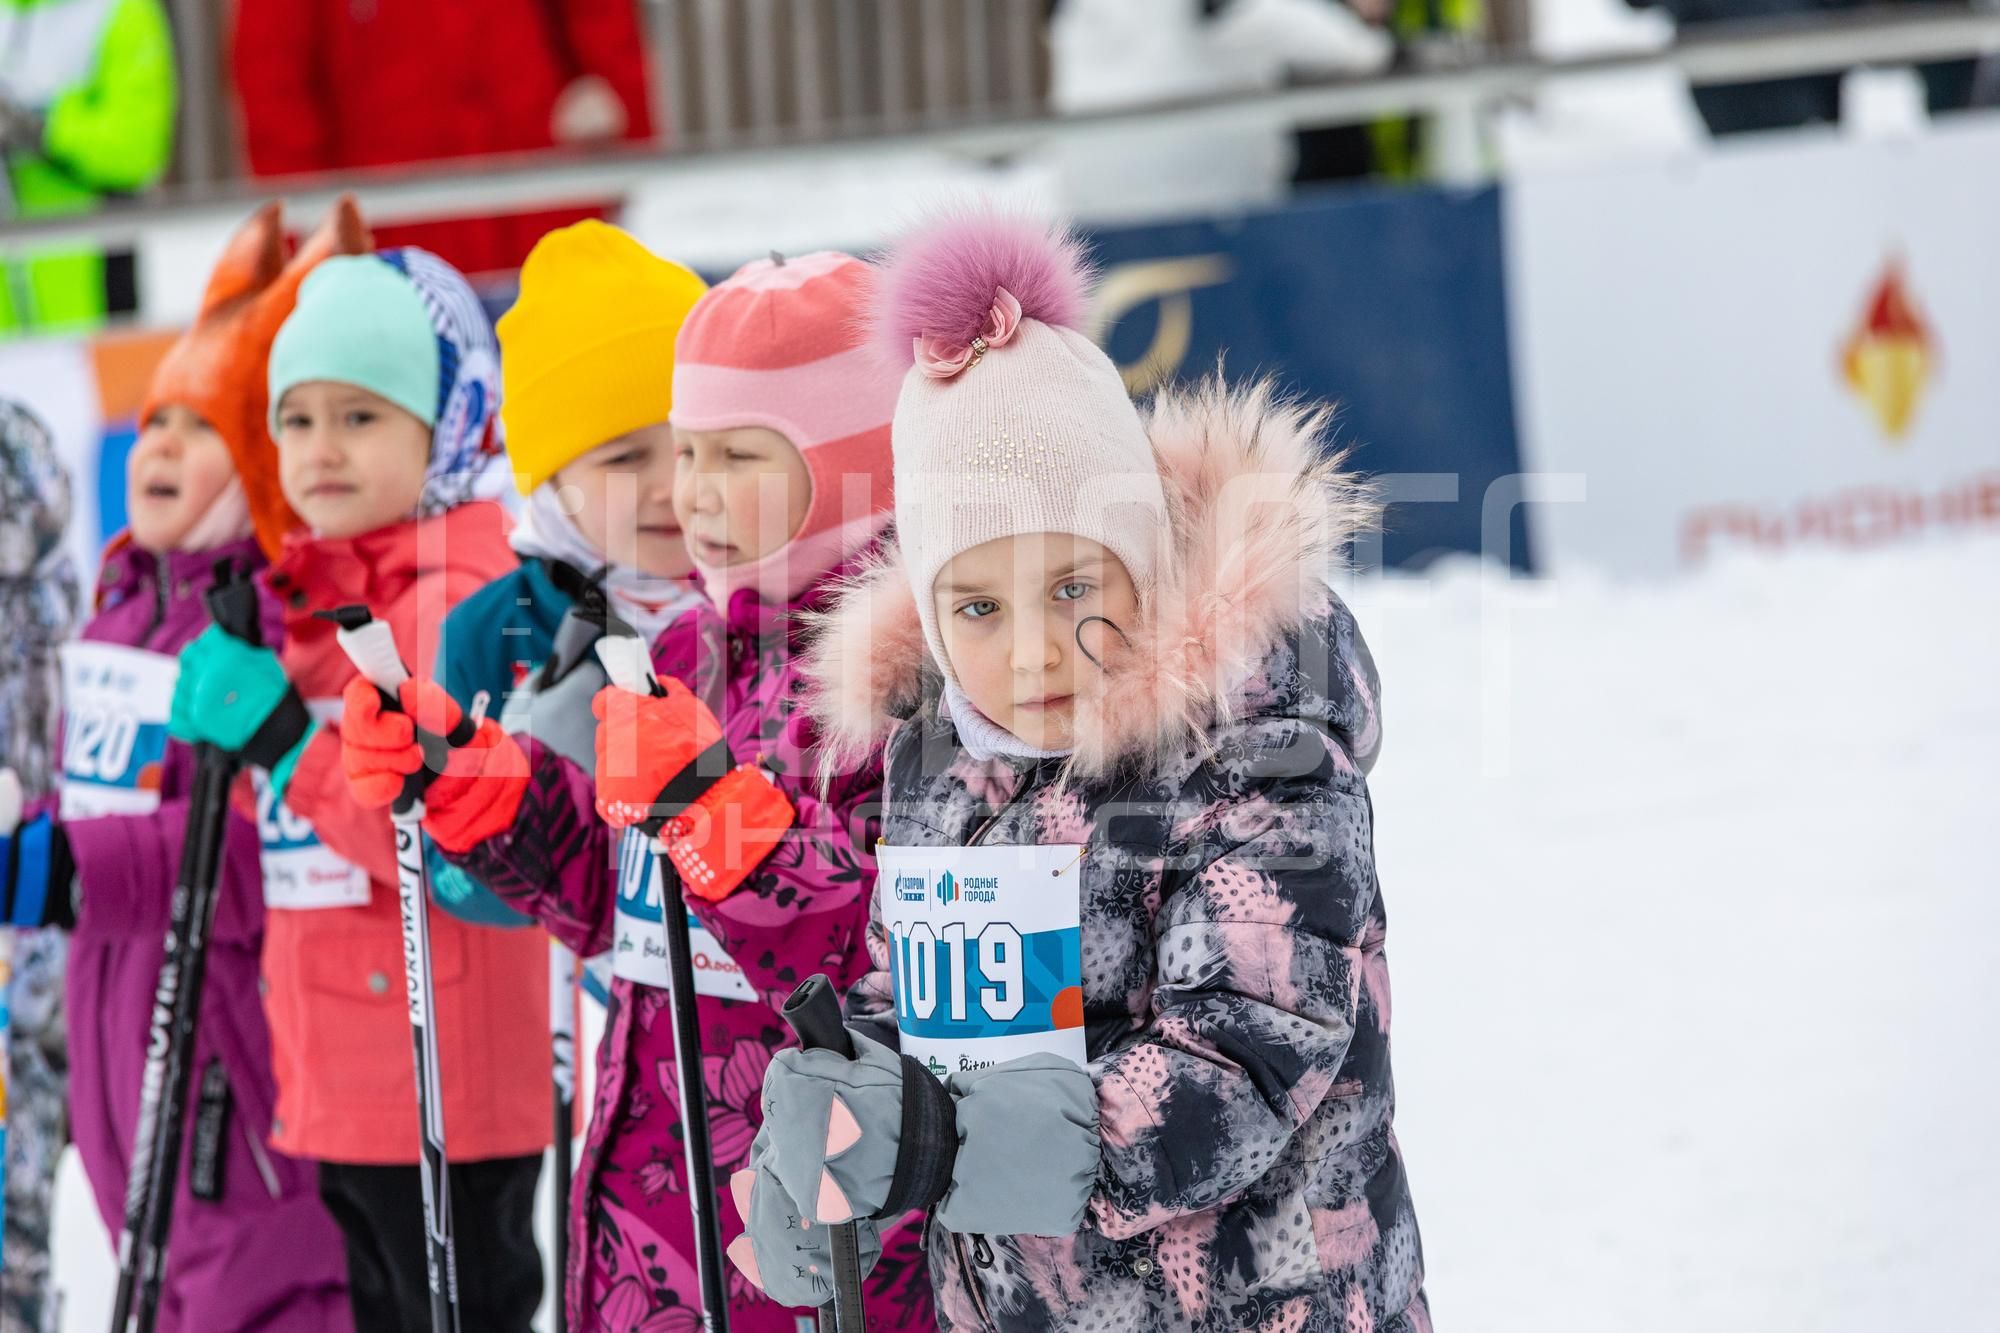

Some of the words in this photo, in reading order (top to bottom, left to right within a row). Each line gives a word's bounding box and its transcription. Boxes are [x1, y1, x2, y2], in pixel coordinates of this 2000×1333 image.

[964, 877, 998, 889] РОДНЫЕ
[964, 891, 996, 903] ГОРОДА
[893, 920, 1025, 1022] 1019
